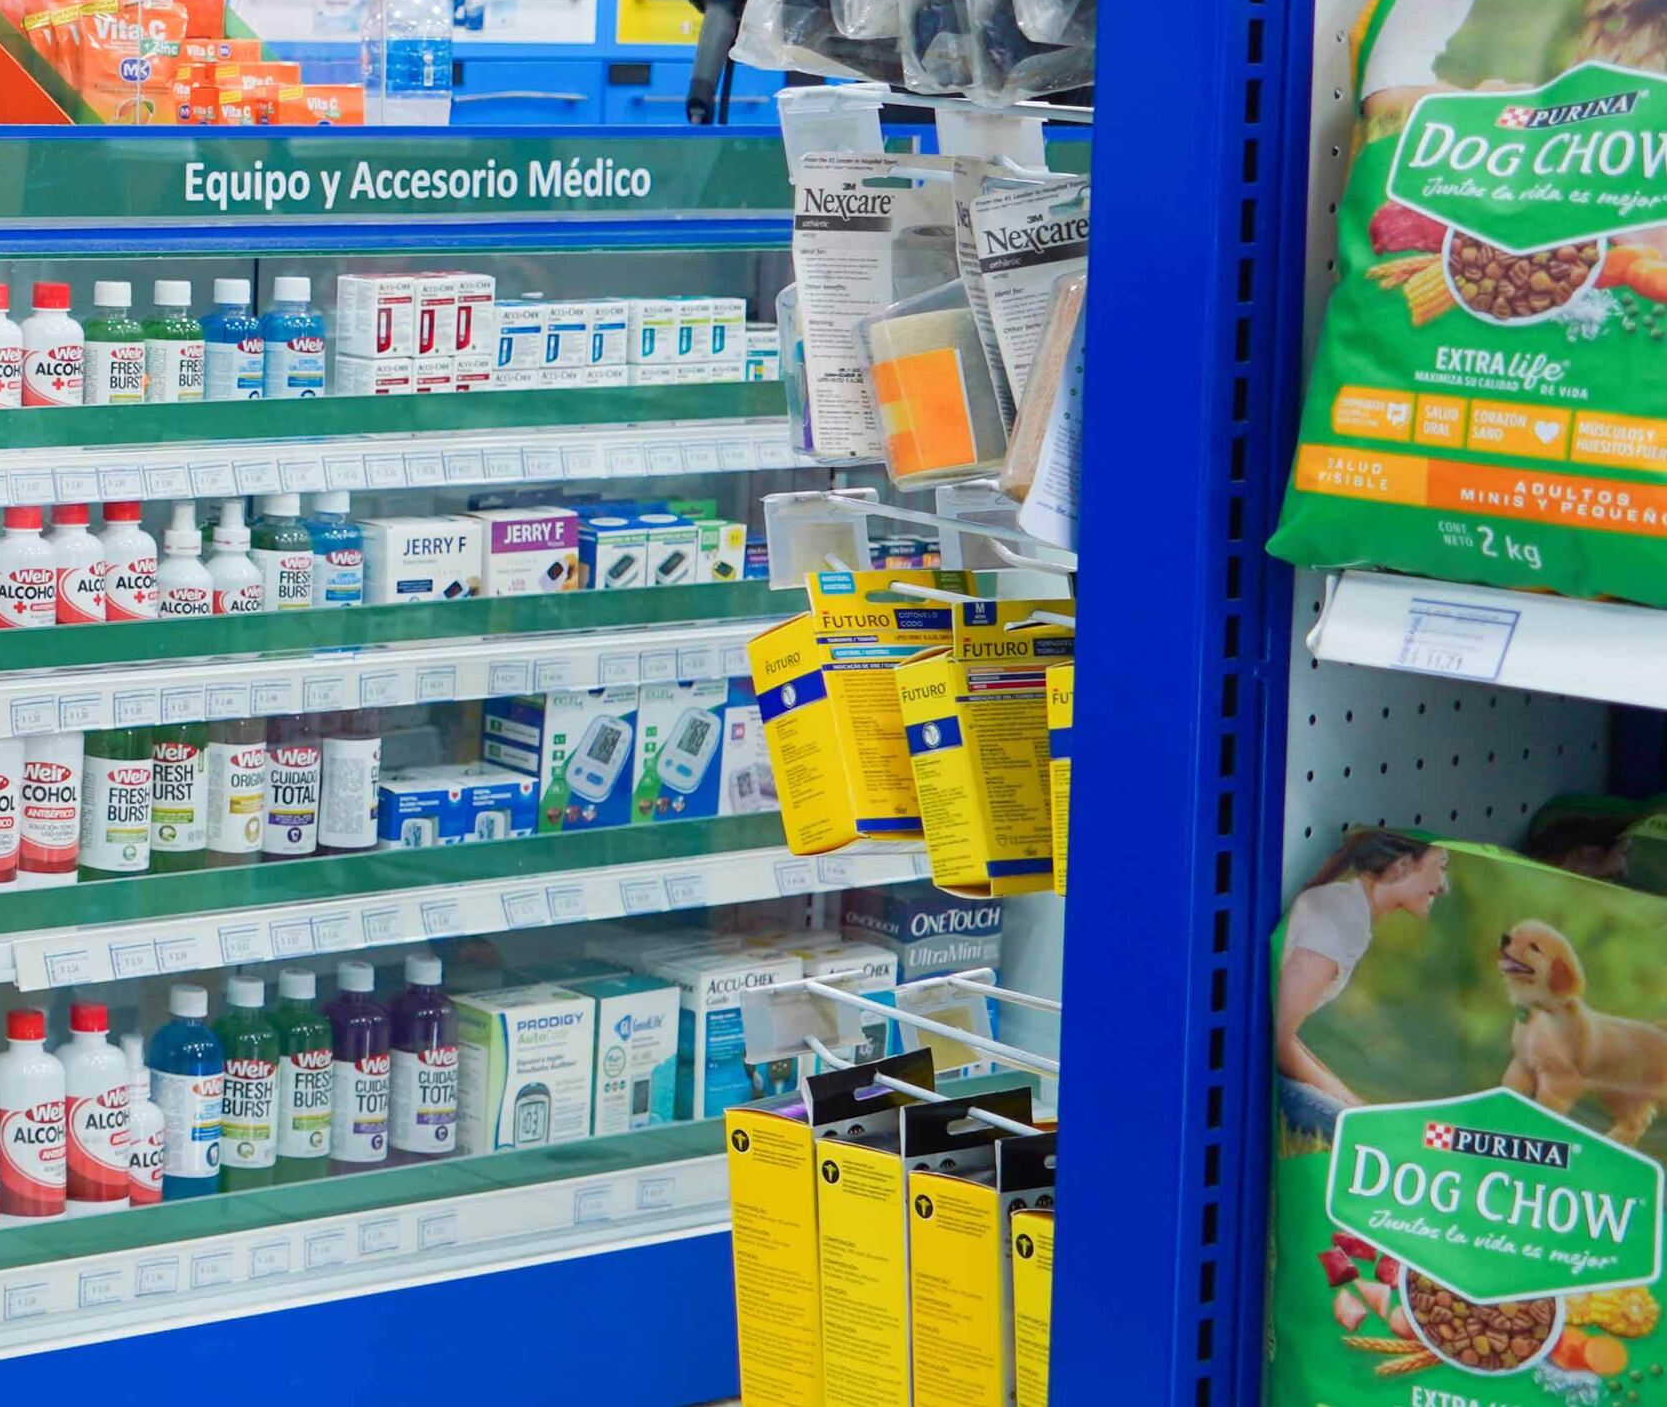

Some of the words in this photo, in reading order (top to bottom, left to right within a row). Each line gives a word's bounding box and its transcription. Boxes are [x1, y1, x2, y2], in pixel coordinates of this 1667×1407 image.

[95, 14, 138, 41] Vita
[149, 20, 167, 40] C
[1532, 95, 1627, 126] PURINA
[1409, 122, 1525, 177] DOG
[184, 161, 310, 209] Equipo
[320, 168, 340, 209] y
[349, 157, 518, 202] Accesorio
[528, 157, 651, 199] Médico
[842, 183, 856, 191] 3M
[804, 188, 892, 221] Nexcare
[1424, 177, 1484, 196] Juntos
[1520, 185, 1563, 201] vida
[1570, 190, 1590, 202] es
[1598, 191, 1660, 216] mejor
[1027, 214, 1043, 224] 3M
[984, 218, 1089, 254] Nexcare
[115, 348, 143, 360] Weir
[293, 338, 325, 352] Weir
[1436, 347, 1503, 376] EXTRA
[1508, 352, 1565, 389] life
[1415, 371, 1462, 385] MAXIMIZA
[1464, 376, 1476, 387] SU
[1479, 378, 1518, 391] CALIDAD
[1560, 387, 1588, 399] VIDA
[1425, 405, 1459, 421] SALUD
[1423, 423, 1450, 437] ORAL
[1472, 426, 1503, 441] SANO
[1328, 457, 1382, 474] SALUD
[1318, 470, 1388, 490] VISIBLE
[1460, 489, 1526, 508] MINIS
[1537, 499, 1548, 509] Y
[1515, 481, 1630, 507] ADULTOS
[504, 524, 550, 544] JERRY
[554, 522, 564, 541] F
[403, 538, 453, 556] JERRY
[458, 537, 467, 552] F
[1477, 526, 1498, 557] 2
[1506, 536, 1542, 570] kg
[16, 570, 53, 583] Weir
[174, 589, 204, 601] Weir
[823, 615, 888, 629] FUTURO
[964, 642, 1028, 657] FUTURO
[765, 651, 801, 675] FUTURO
[902, 684, 945, 703] FUTURO
[276, 747, 320, 766] Weir
[113, 769, 151, 784] Weir
[271, 769, 318, 784] CUIDADO
[109, 788, 151, 805] FRESH
[272, 785, 316, 804] TOTAL
[109, 805, 150, 822] BURST
[909, 943, 982, 967] UltraMini
[517, 1012, 583, 1032] PRODIGY
[227, 1061, 272, 1077] Weir
[223, 1080, 272, 1099] FRESH
[221, 1098, 271, 1117] BURST
[1456, 1131, 1563, 1166] PURINA
[1348, 1143, 1463, 1213] DOG
[1477, 1171, 1637, 1243] CHOW
[1369, 1210, 1439, 1241] Juntos
[1447, 1223, 1467, 1244] la
[1475, 1233, 1516, 1255] vida
[1523, 1243, 1541, 1259] es
[1550, 1246, 1611, 1275] mejor
